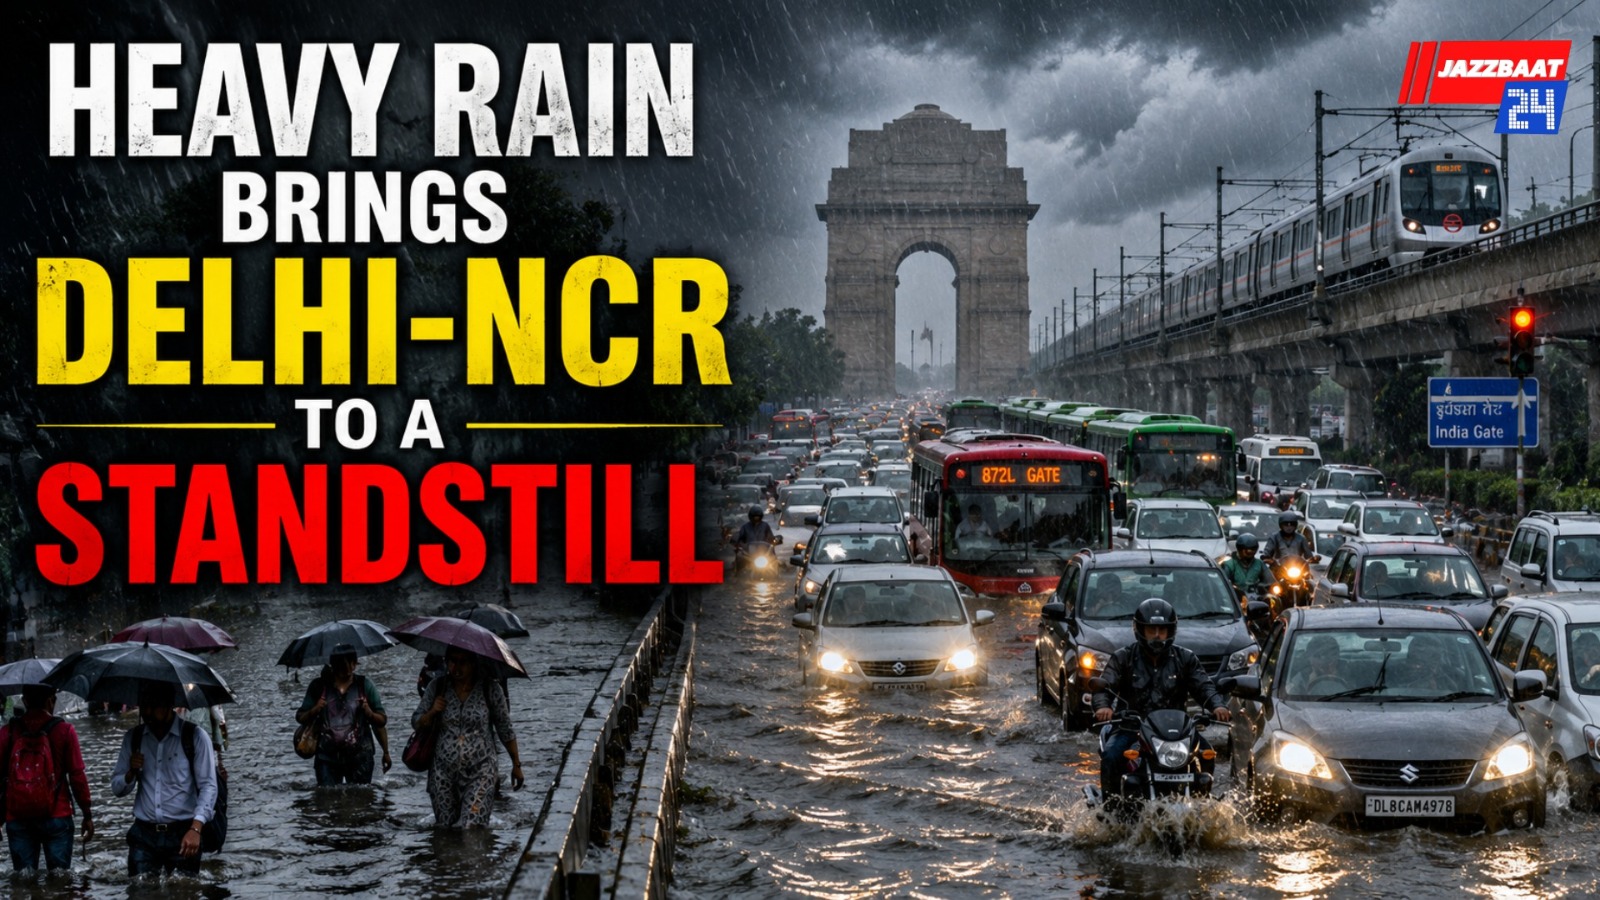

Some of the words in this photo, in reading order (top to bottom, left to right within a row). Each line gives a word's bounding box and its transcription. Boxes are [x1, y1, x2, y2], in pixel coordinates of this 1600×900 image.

[1435, 425, 1469, 439] India
[1473, 424, 1504, 439] Gate
[981, 466, 1016, 483] 872L
[1026, 466, 1061, 483] GATE
[1374, 799, 1452, 813] DL8CAM4978
